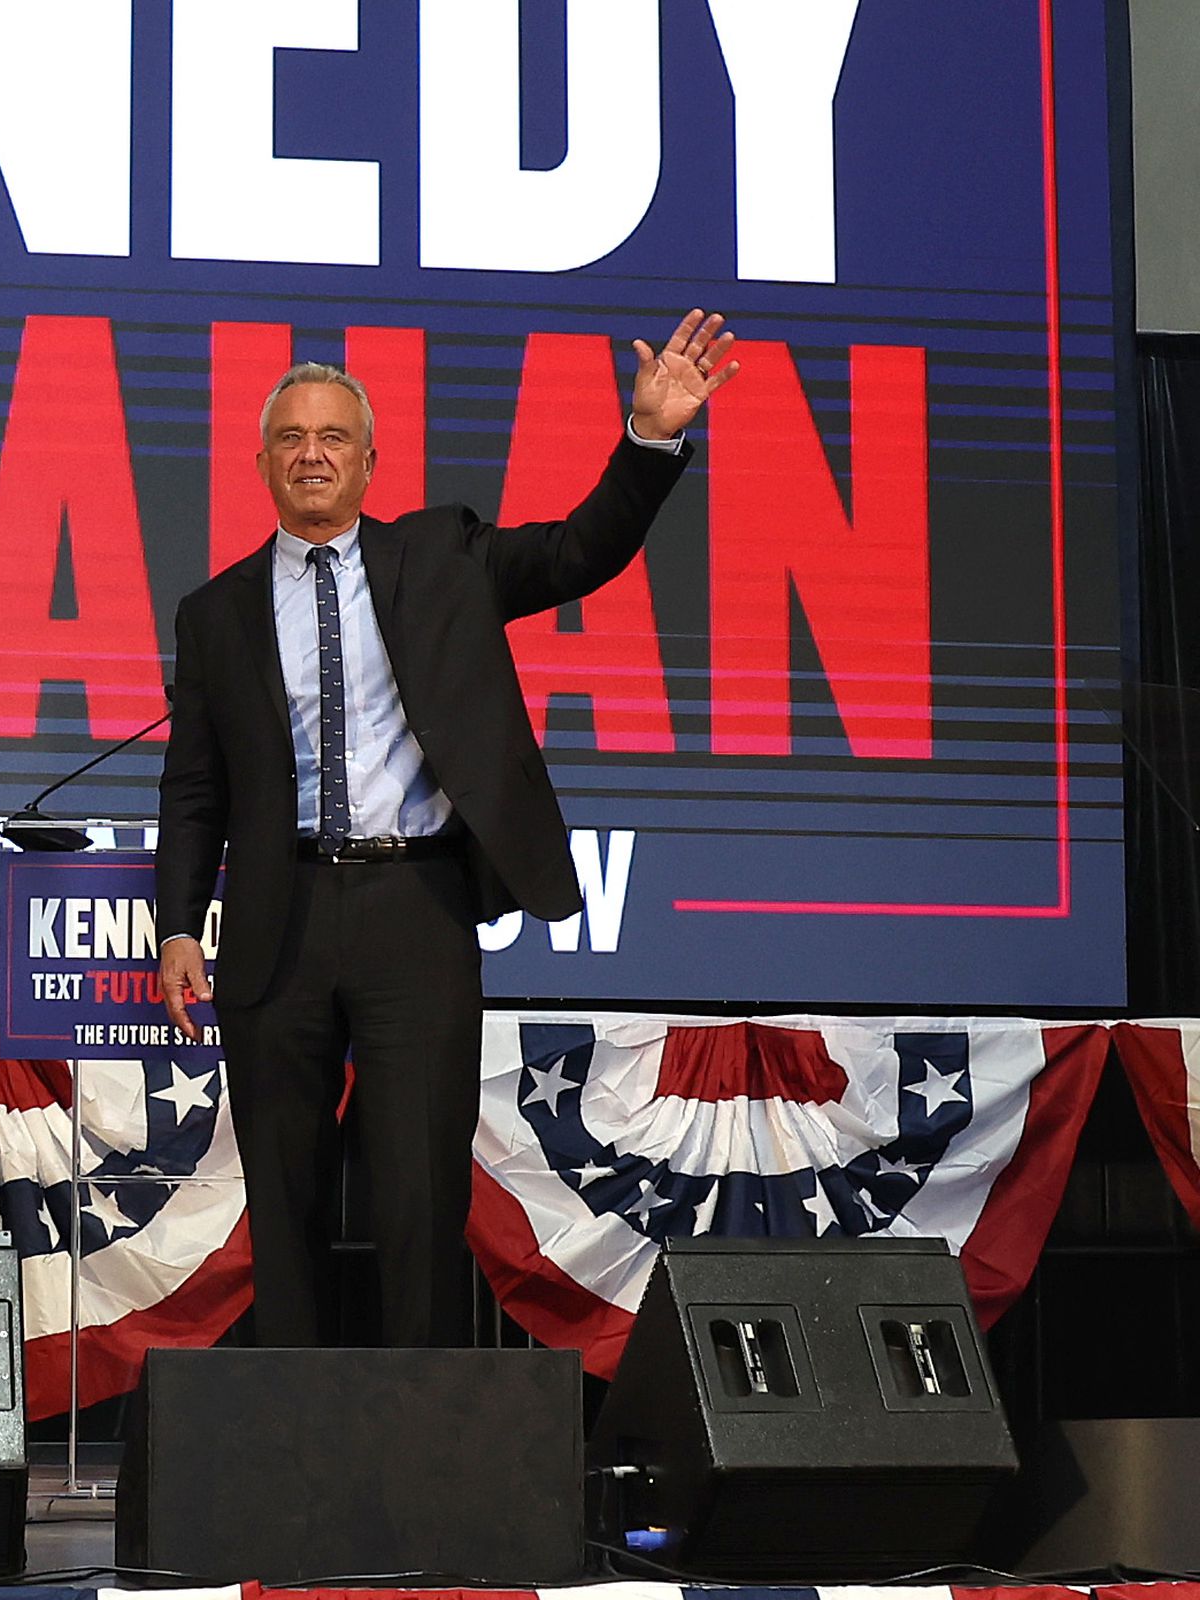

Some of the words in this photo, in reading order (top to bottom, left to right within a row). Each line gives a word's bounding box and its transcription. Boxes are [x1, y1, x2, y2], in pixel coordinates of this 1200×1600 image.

[32, 973, 83, 1000] TEXT
[74, 1024, 105, 1045] THE
[109, 1024, 169, 1046] FUTURE
